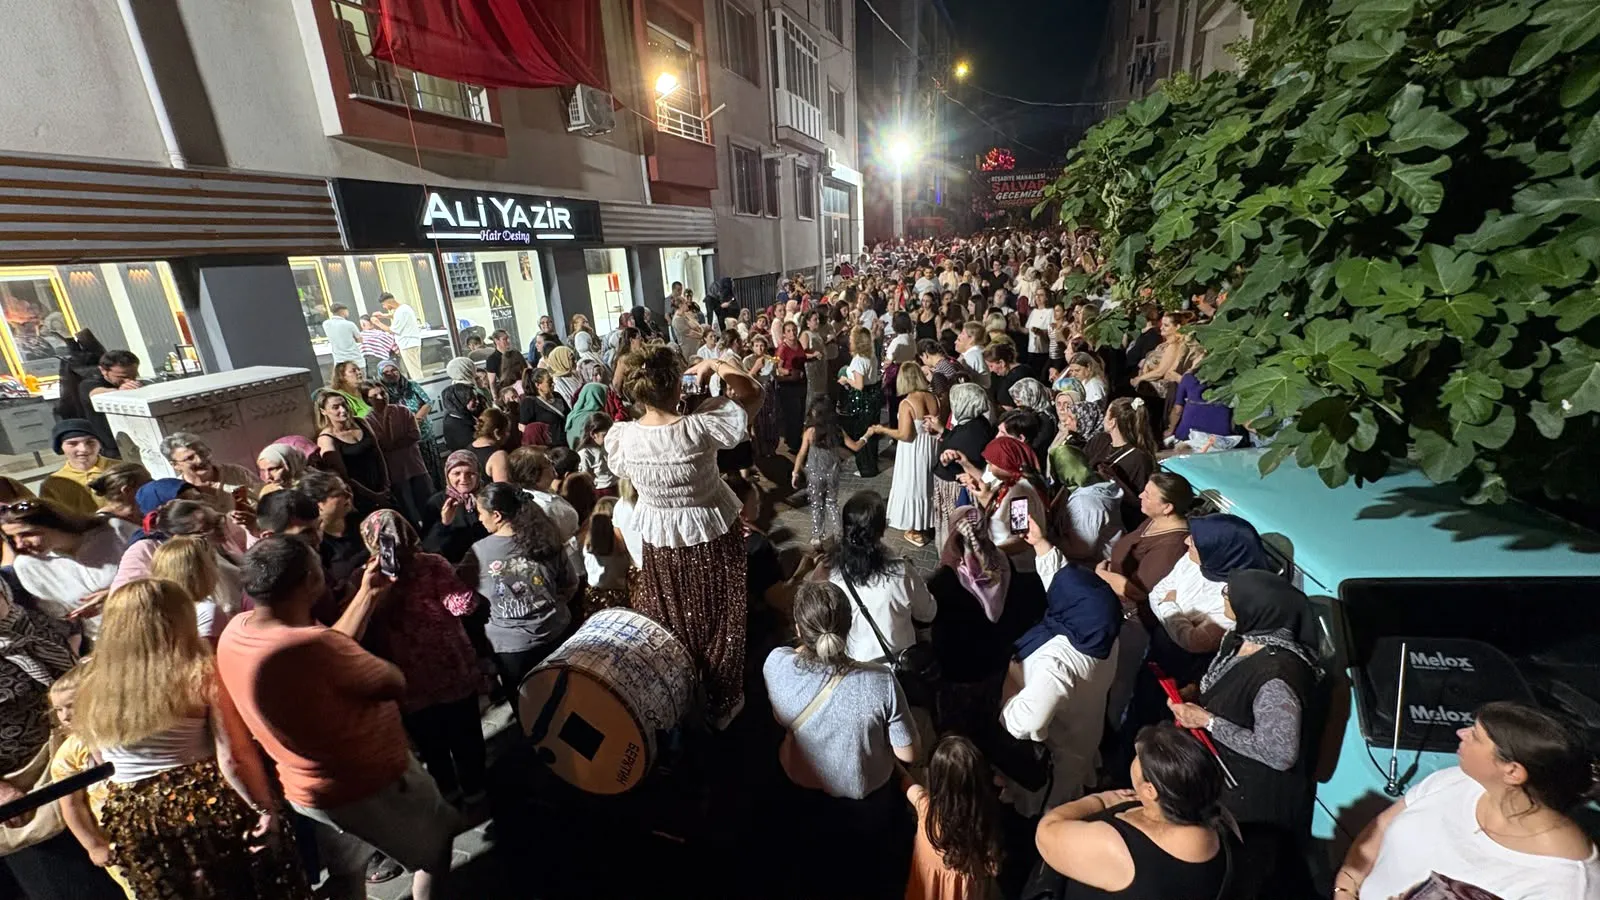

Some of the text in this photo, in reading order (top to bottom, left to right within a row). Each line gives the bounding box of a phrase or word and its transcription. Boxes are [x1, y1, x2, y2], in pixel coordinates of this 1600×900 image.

[995, 189, 1043, 200] GECEMİZE
[480, 229, 501, 241] Hair
[1409, 651, 1473, 667] Melox
[1409, 705, 1474, 722] Melox
